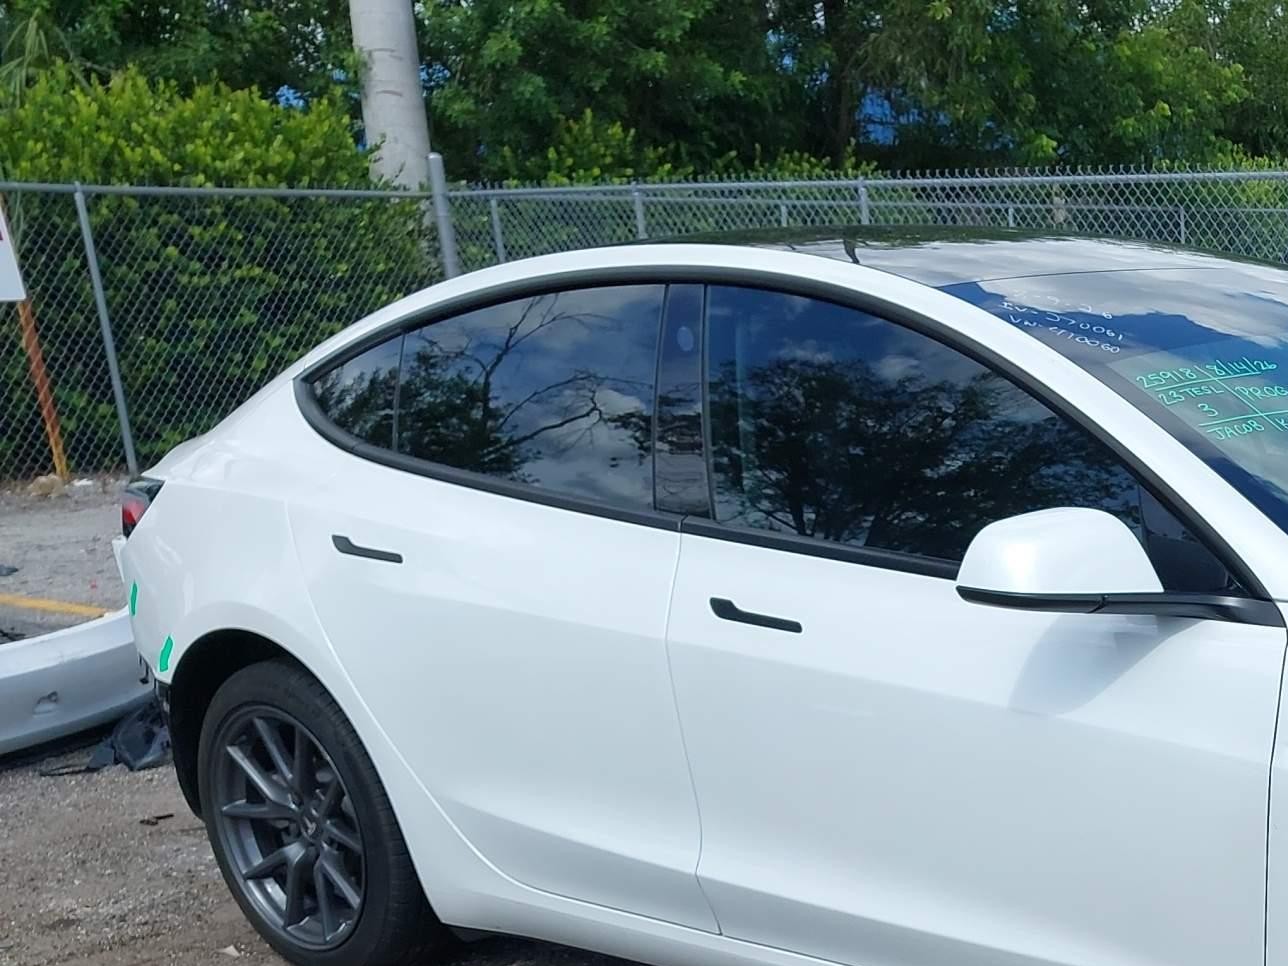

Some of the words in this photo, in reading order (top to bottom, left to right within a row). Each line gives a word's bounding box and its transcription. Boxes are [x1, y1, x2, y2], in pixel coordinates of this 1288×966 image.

[1205, 357, 1277, 376] 8/14/26
[1136, 367, 1197, 388] 25918
[1158, 390, 1185, 406] 23
[1180, 385, 1225, 398] TESL
[1197, 403, 1219, 417] 3
[1206, 419, 1265, 440] JACOB
